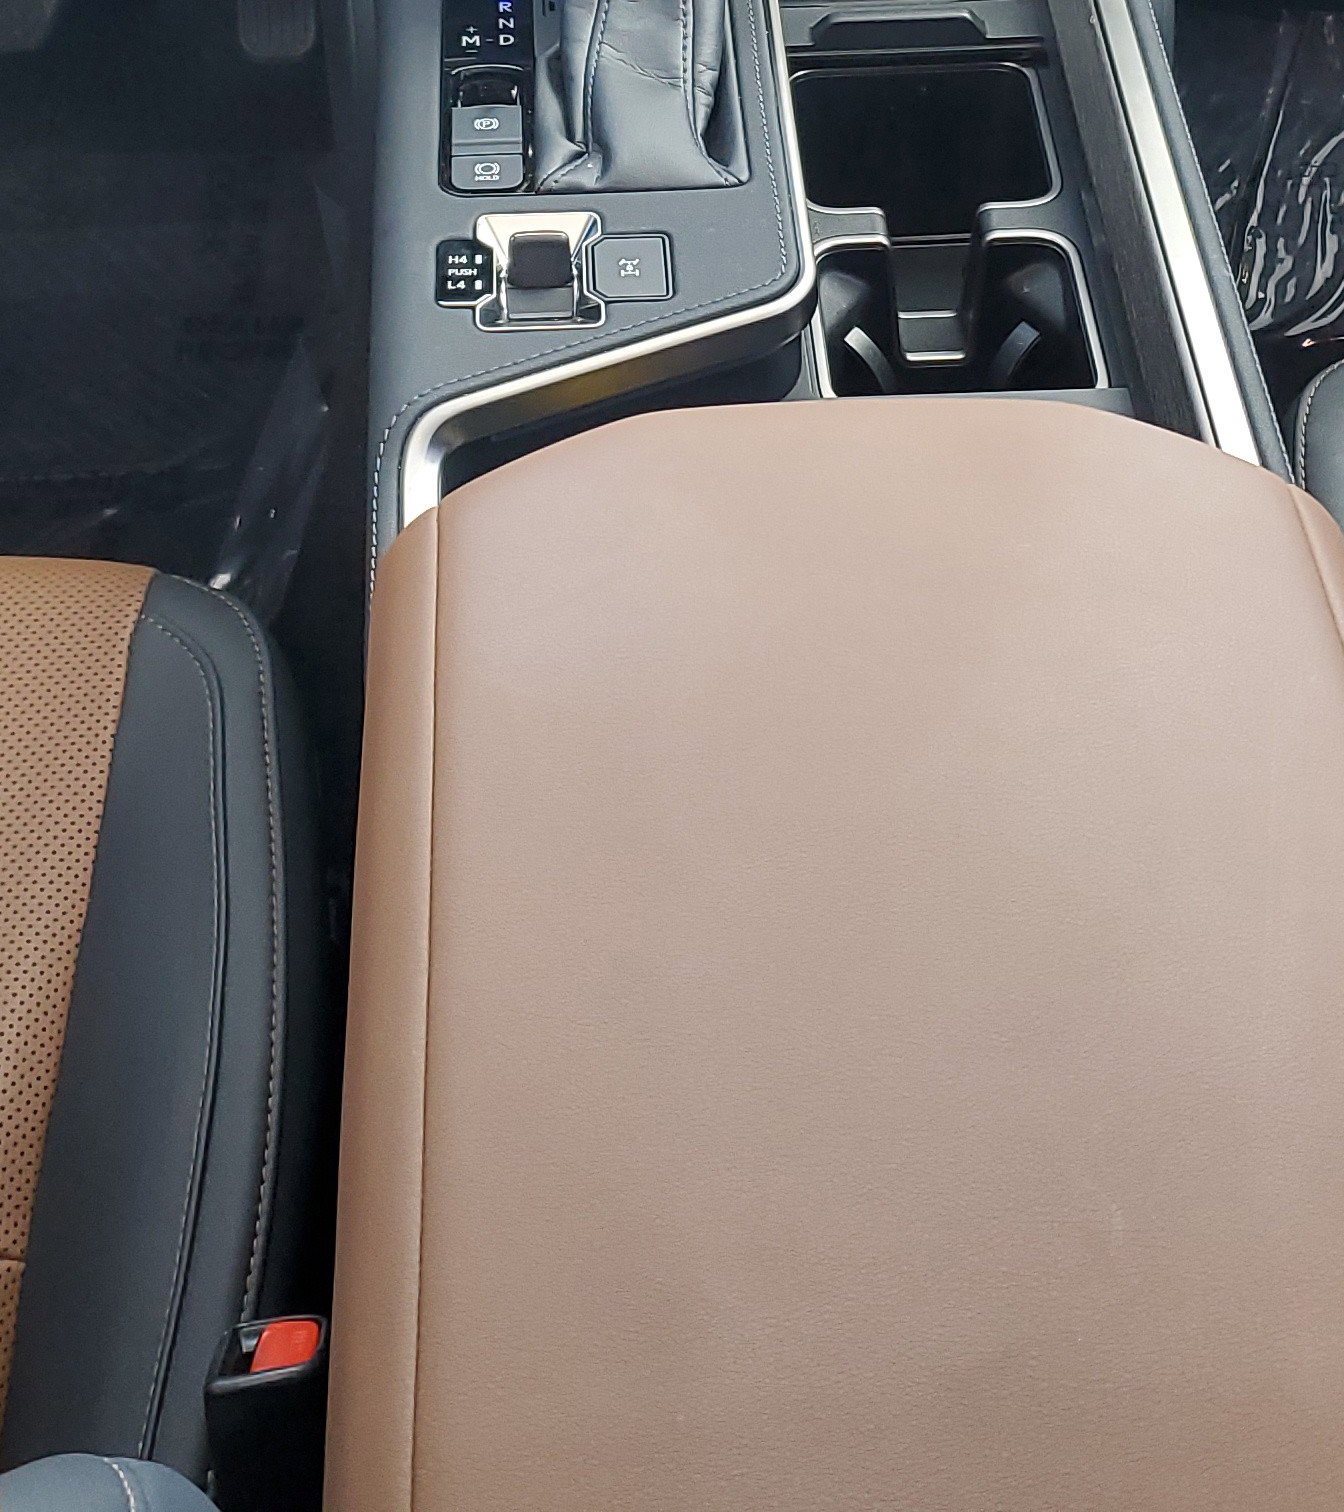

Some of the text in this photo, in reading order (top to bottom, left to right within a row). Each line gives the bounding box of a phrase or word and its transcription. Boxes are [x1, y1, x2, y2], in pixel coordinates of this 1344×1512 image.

[499, 1, 512, 13] R
[498, 17, 514, 30] N
[461, 34, 515, 47] M D
[474, 174, 500, 182] HOLD
[448, 255, 468, 264] H4
[447, 268, 478, 276] PUSH
[447, 280, 466, 290] L4
